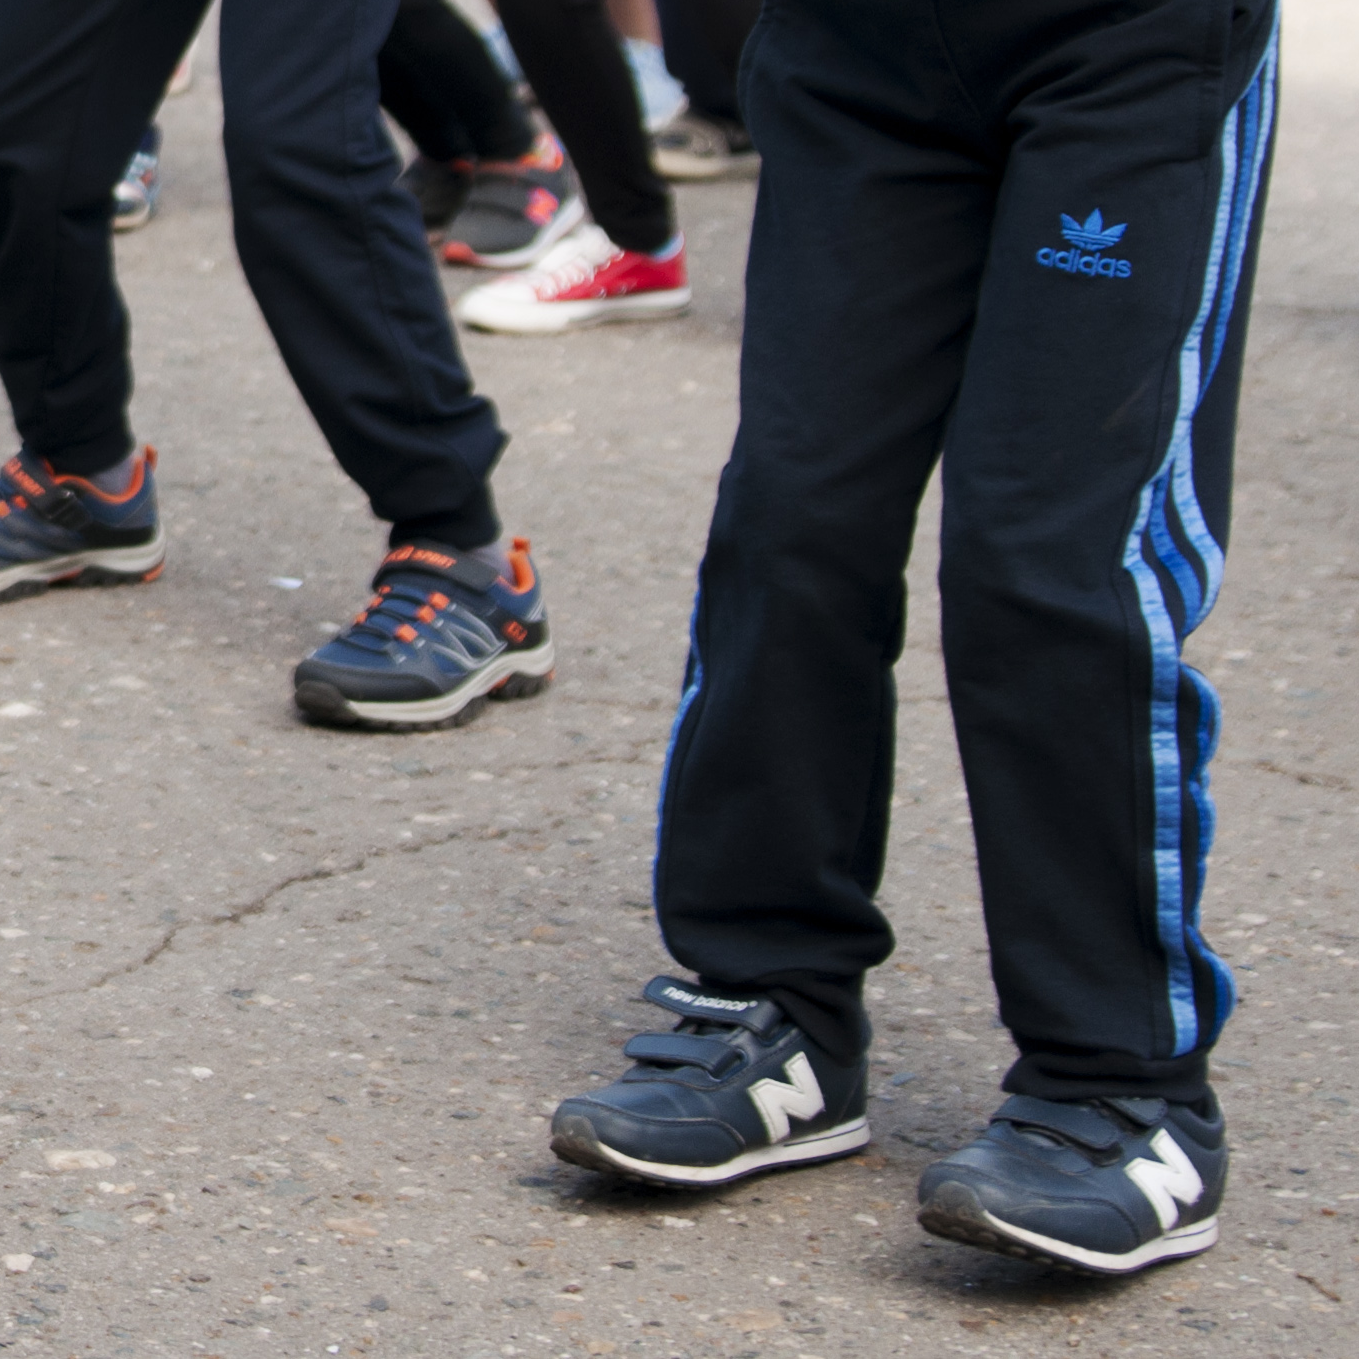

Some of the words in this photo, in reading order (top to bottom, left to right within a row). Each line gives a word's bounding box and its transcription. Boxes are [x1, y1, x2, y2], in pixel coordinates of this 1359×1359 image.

[1036, 246, 1132, 278] adidas
[411, 547, 457, 569] SPORT
[663, 986, 697, 1003] new
